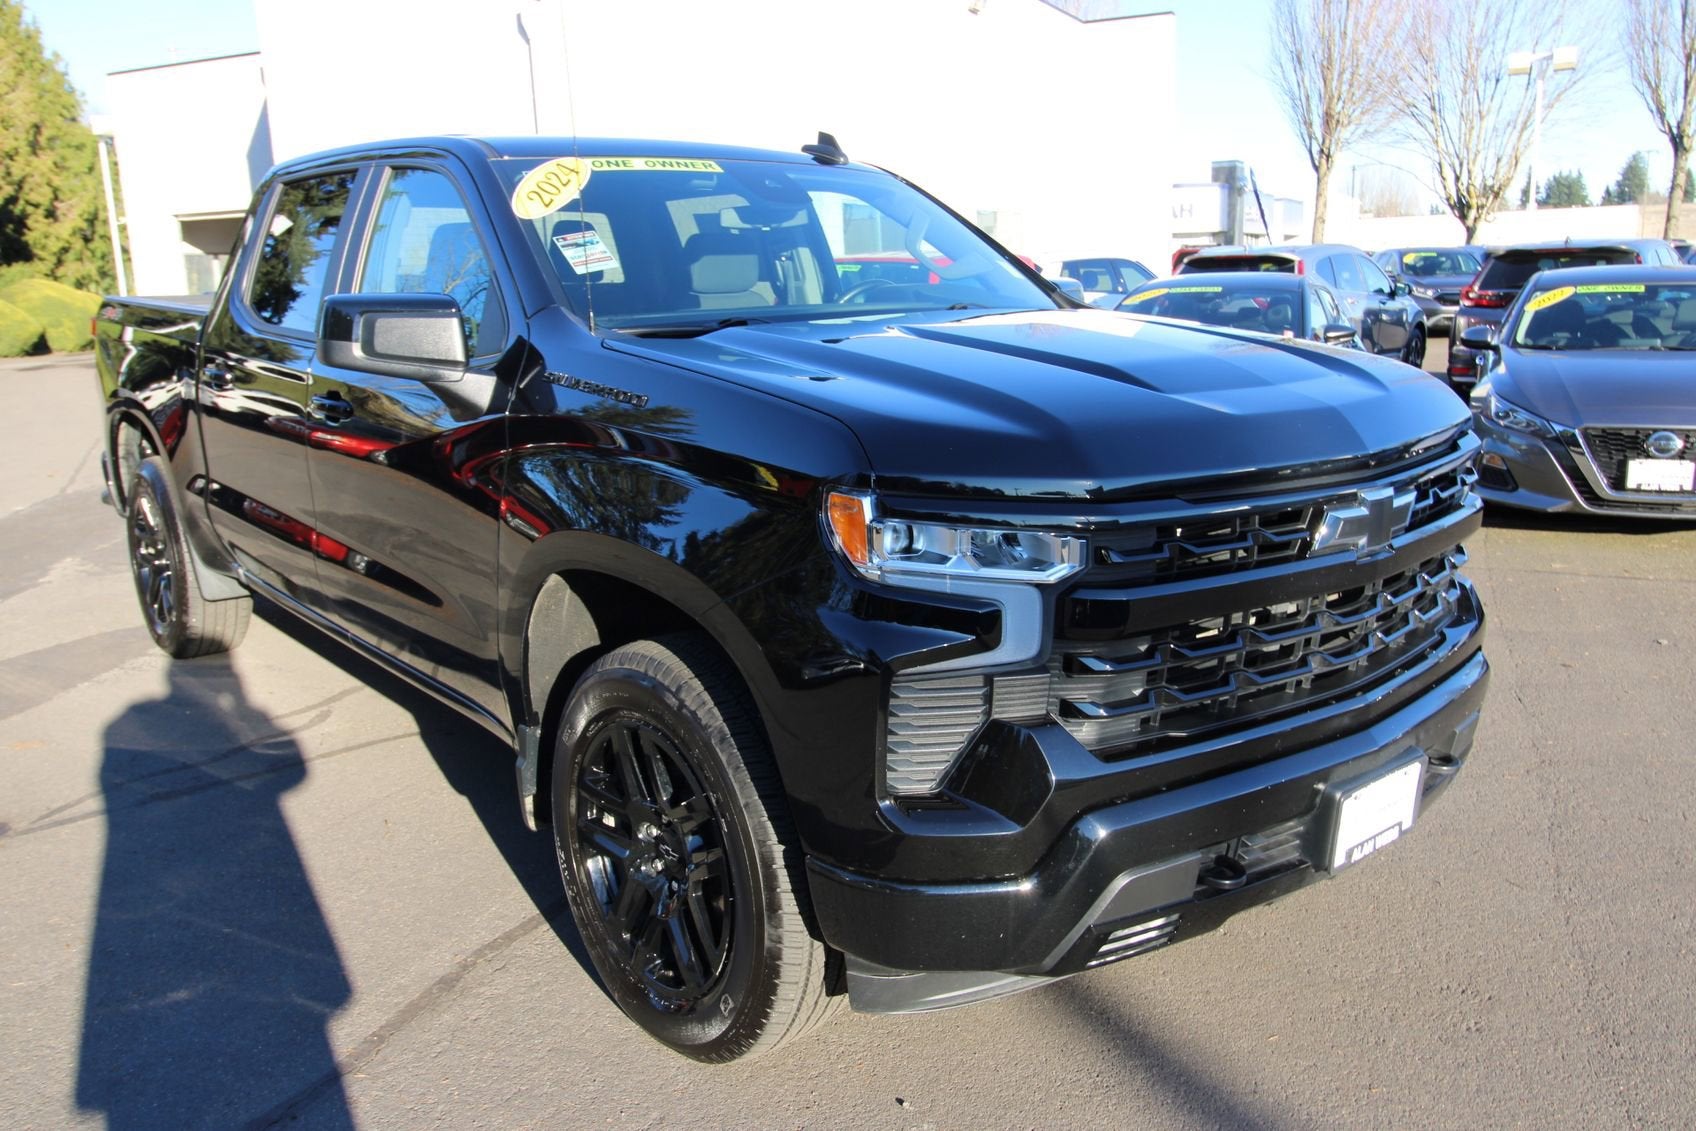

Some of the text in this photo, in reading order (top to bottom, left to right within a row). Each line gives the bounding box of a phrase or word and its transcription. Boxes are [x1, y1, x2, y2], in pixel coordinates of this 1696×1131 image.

[591, 159, 717, 170] ONE OWNER
[527, 162, 580, 208] 2024
